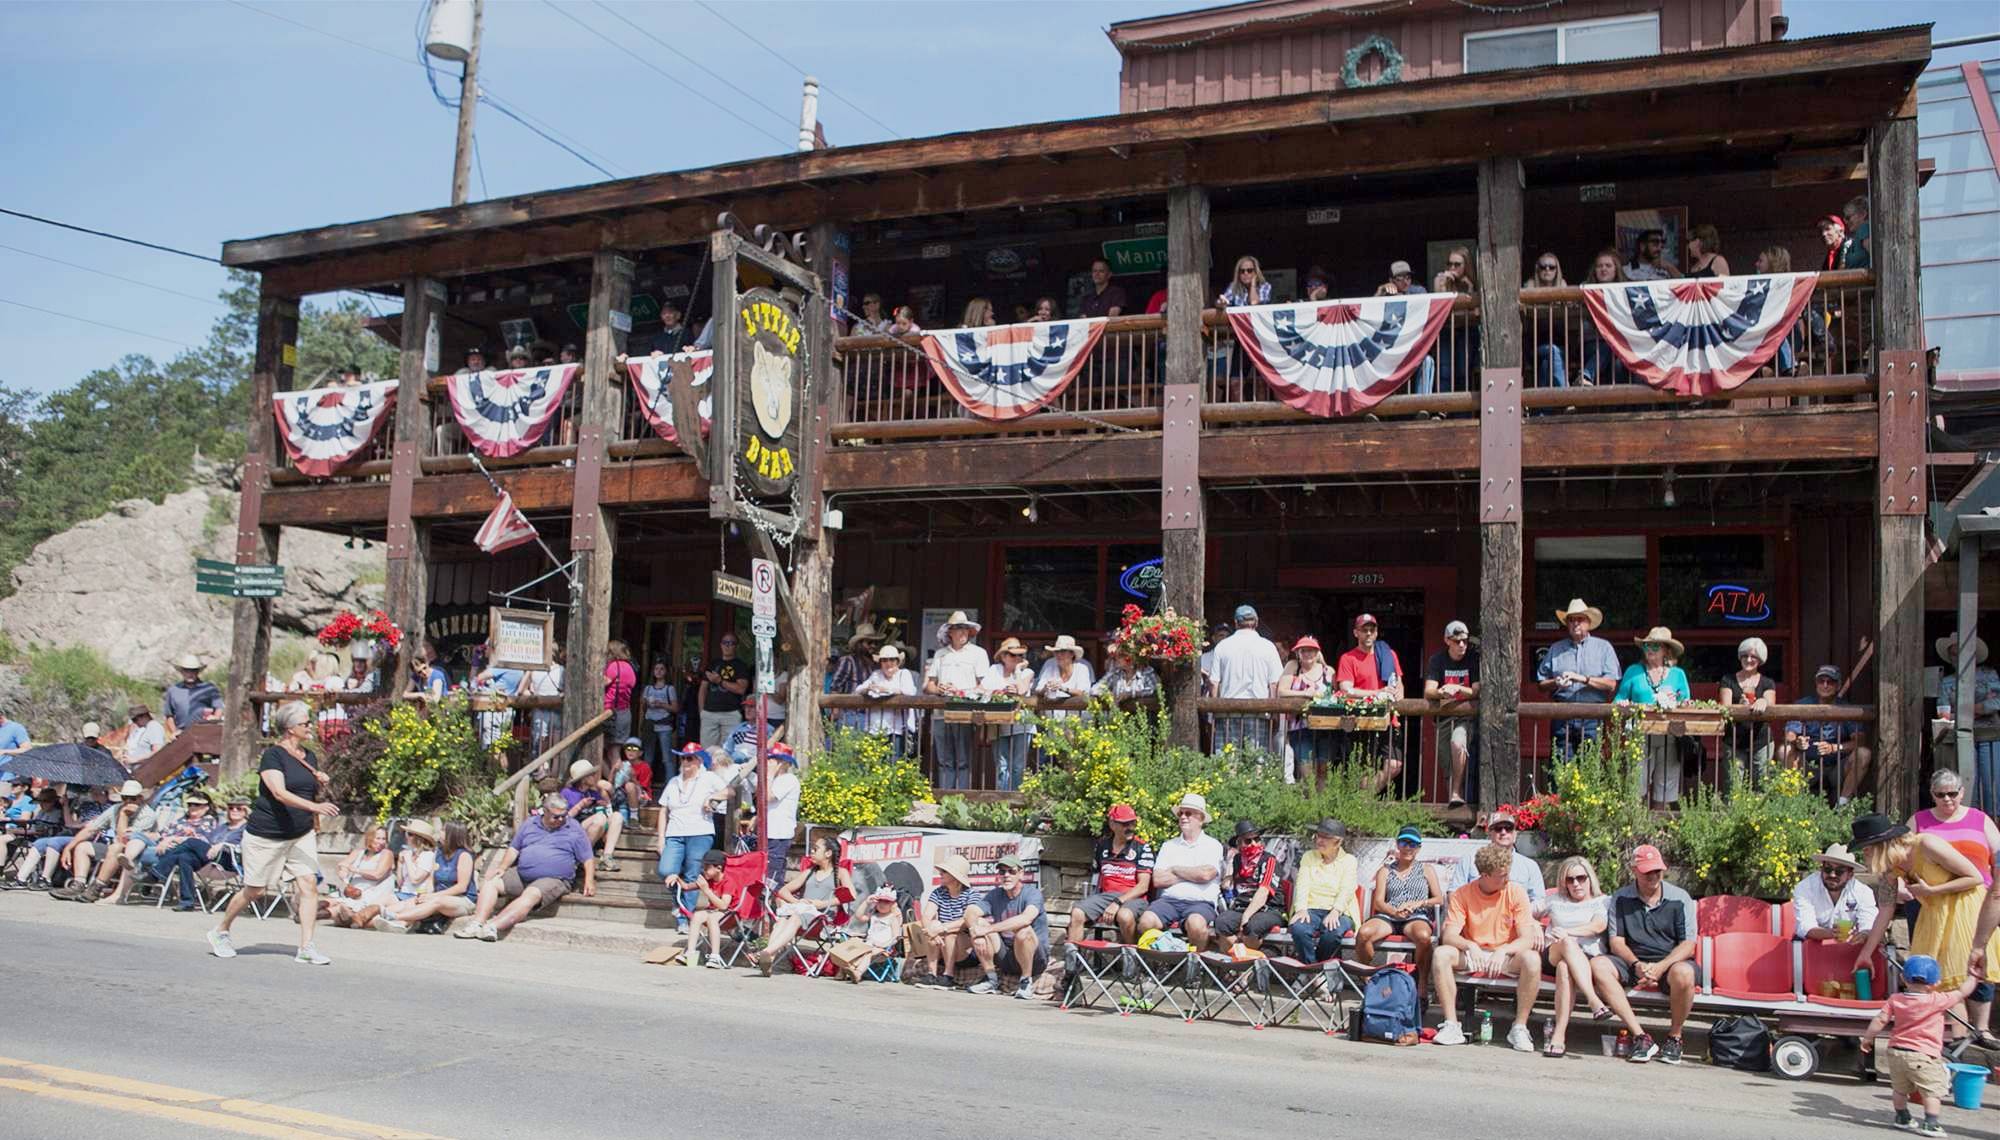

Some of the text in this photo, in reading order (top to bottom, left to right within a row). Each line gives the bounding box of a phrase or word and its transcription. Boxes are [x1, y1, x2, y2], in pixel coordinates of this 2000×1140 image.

[741, 302, 800, 355] LITTLE
[746, 434, 794, 479] BEAR
[1351, 574, 1385, 584] 28075
[1707, 591, 1765, 613] ATM
[886, 841, 900, 858] IT
[901, 840, 920, 858] ALL
[970, 845, 995, 861] LITTLE
